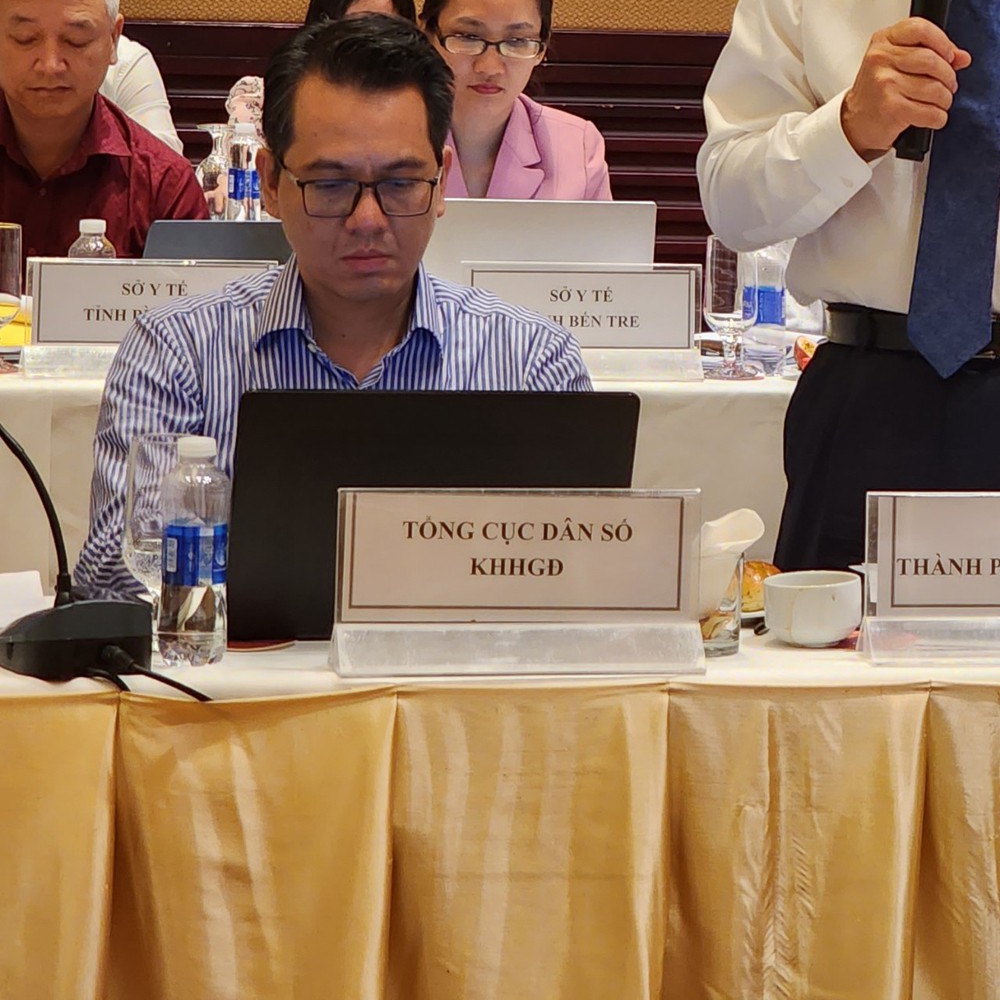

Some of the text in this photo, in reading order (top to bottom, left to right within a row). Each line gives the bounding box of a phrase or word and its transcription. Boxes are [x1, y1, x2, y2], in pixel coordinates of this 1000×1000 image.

[150, 283, 161, 296] Y
[166, 280, 188, 296] TẾ
[576, 290, 588, 302] Y
[592, 286, 614, 302] TẾ
[606, 315, 640, 328] TRE
[402, 515, 634, 546] TỔNG CỤC DÂN SỐ
[470, 557, 564, 577] KHHGĐ
[897, 552, 982, 576] THÀNH
